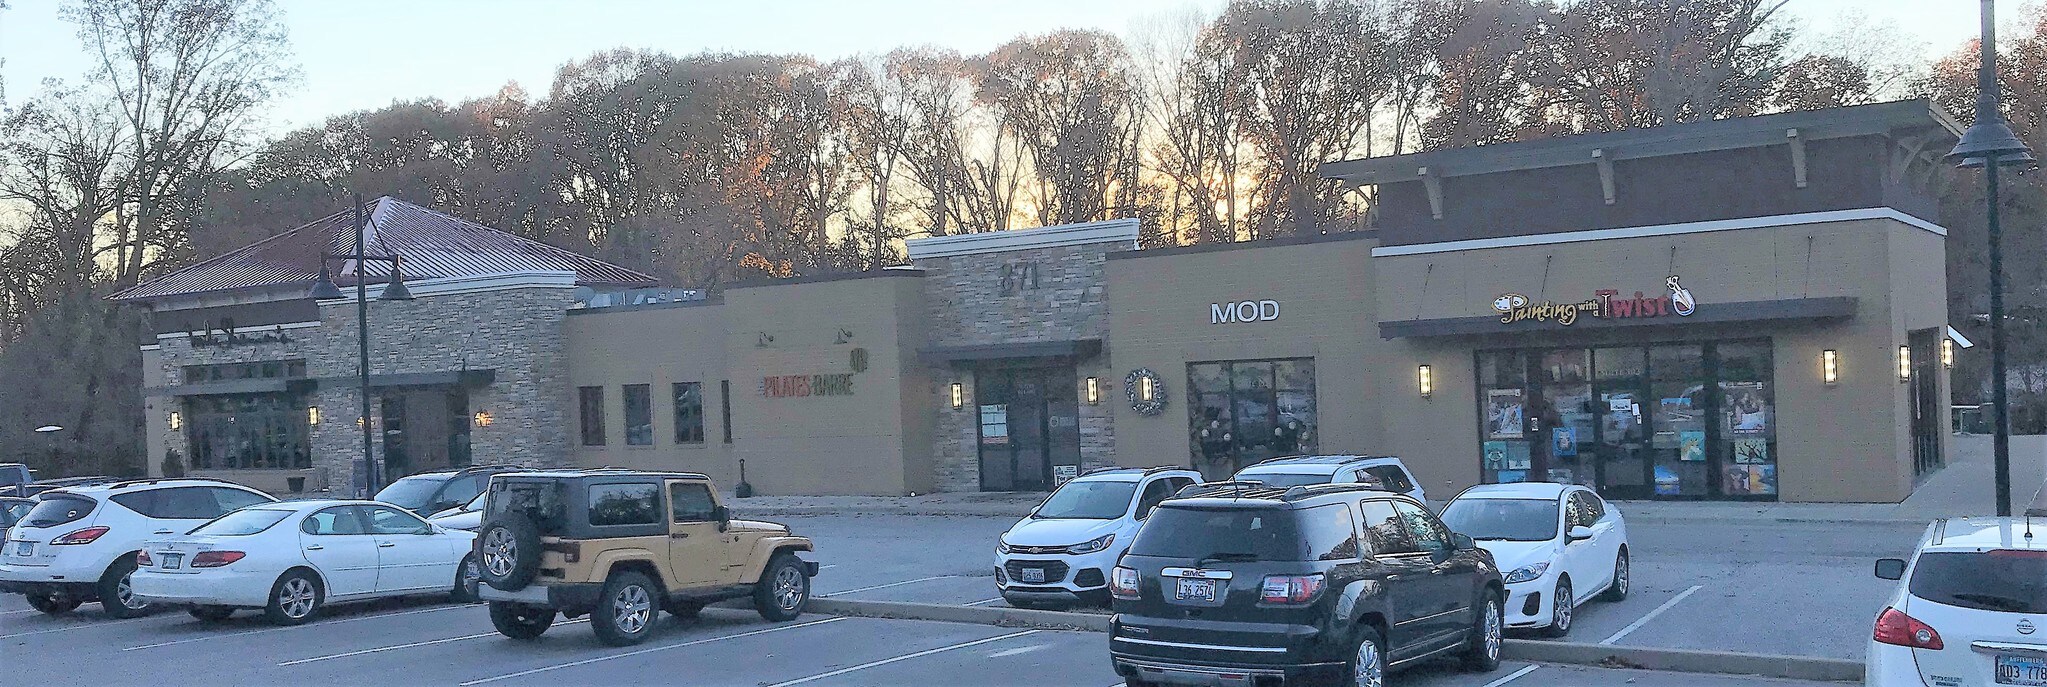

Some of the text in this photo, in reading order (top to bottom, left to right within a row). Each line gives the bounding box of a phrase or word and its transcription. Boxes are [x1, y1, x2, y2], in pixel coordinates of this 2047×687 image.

[1000, 262, 1040, 294] 871
[1210, 300, 1280, 323] MOD
[1492, 289, 1668, 326] Painting with Twist
